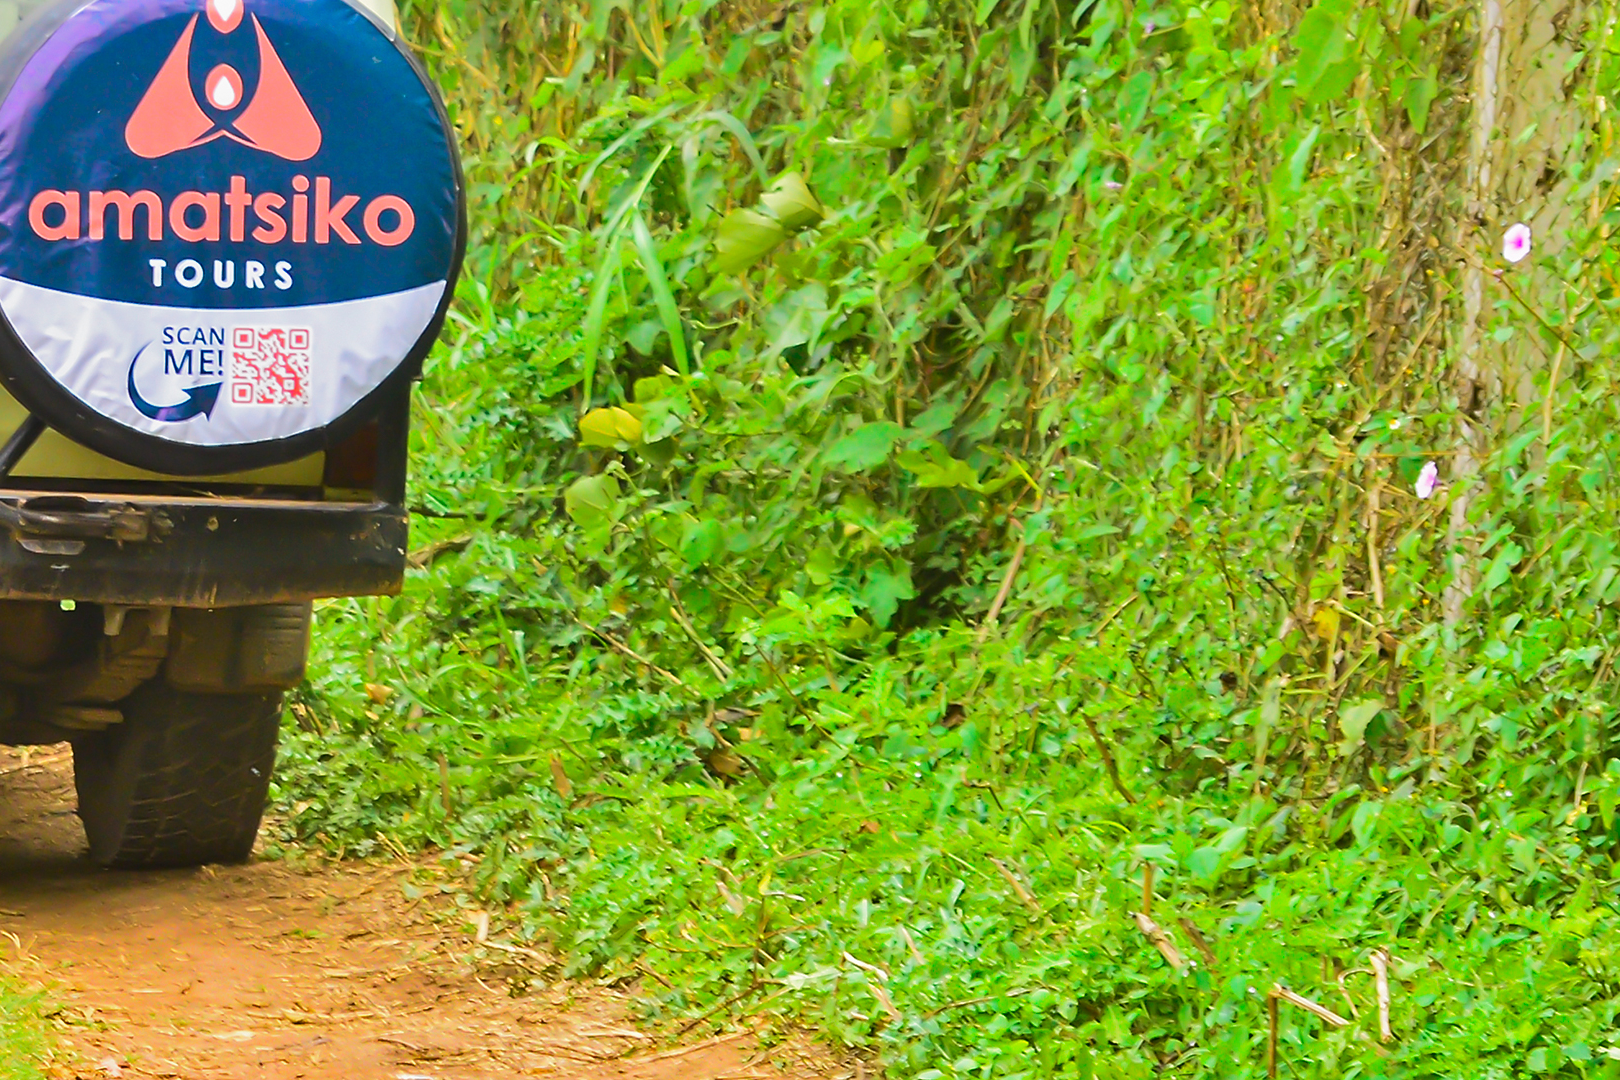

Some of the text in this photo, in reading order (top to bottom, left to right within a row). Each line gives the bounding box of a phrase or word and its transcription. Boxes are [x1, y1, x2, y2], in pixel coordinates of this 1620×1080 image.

[28, 174, 416, 247] amatsiko
[148, 259, 294, 290] TOURS
[162, 326, 226, 346] SCAN
[163, 348, 225, 376] ME!
